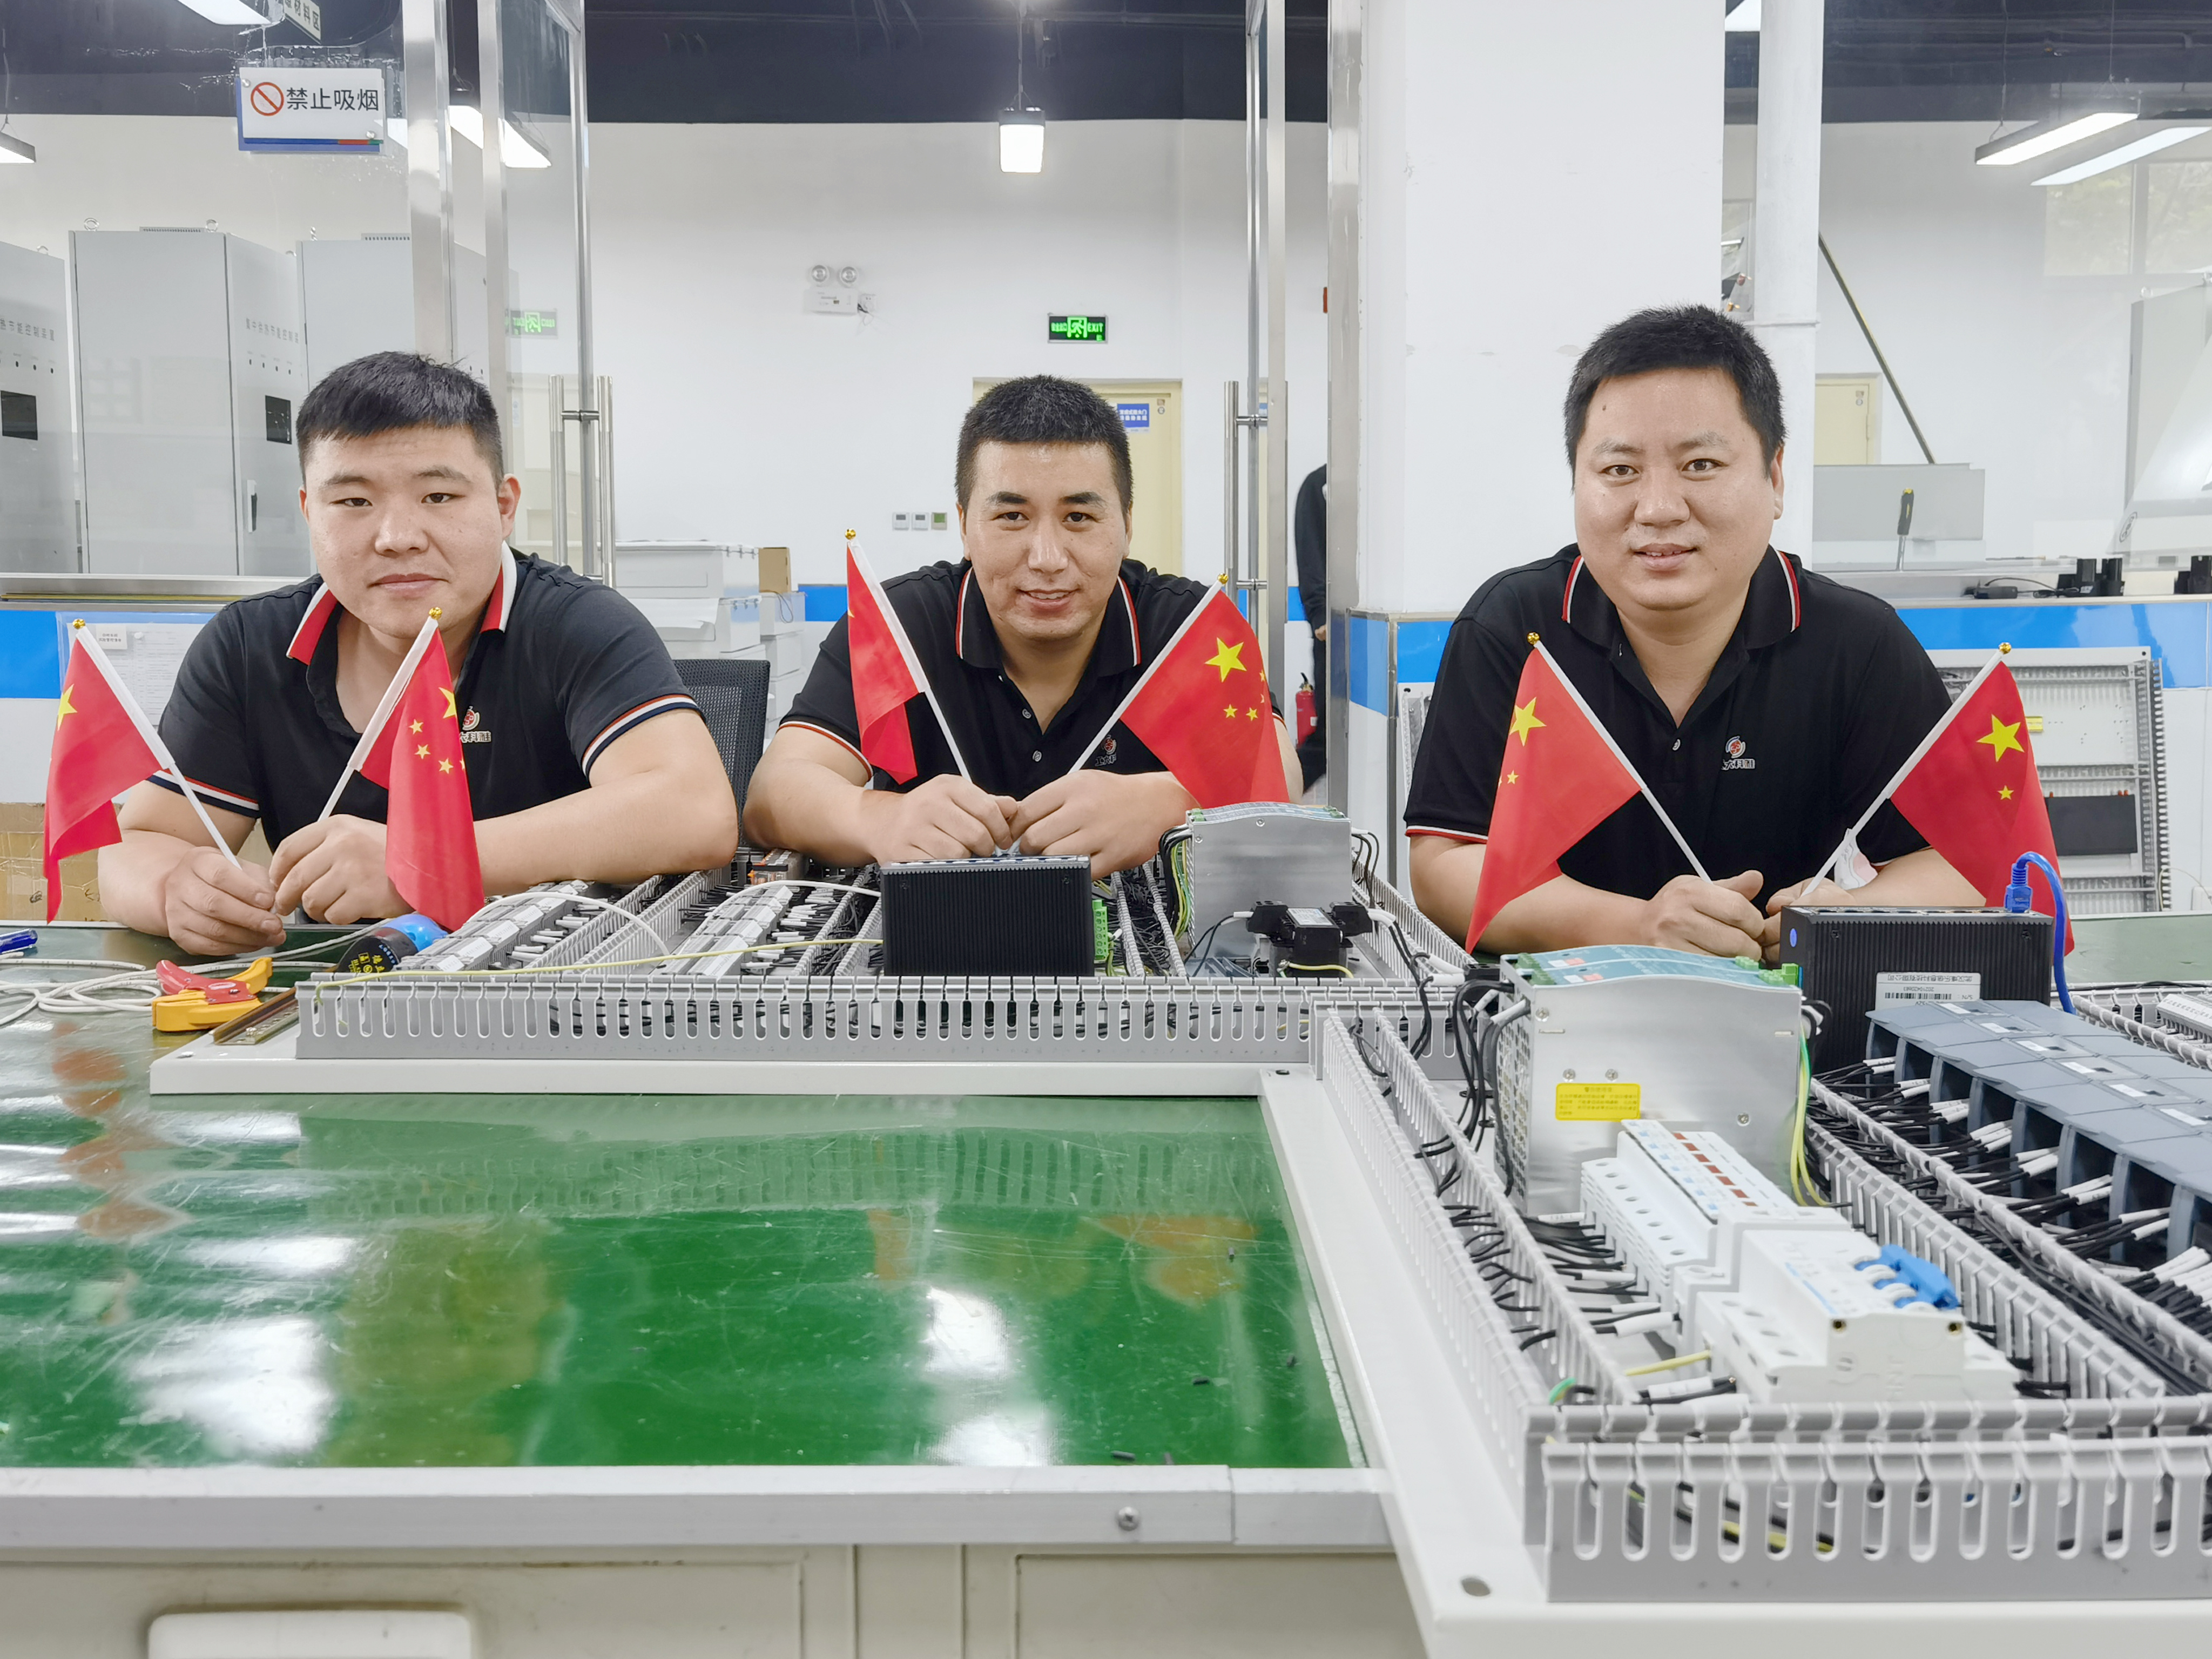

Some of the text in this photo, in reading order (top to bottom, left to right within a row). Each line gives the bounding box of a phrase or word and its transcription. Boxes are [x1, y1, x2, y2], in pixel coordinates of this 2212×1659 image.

[286, 87, 379, 111] 禁止吸烟
[1087, 322, 1103, 332] EXIT
